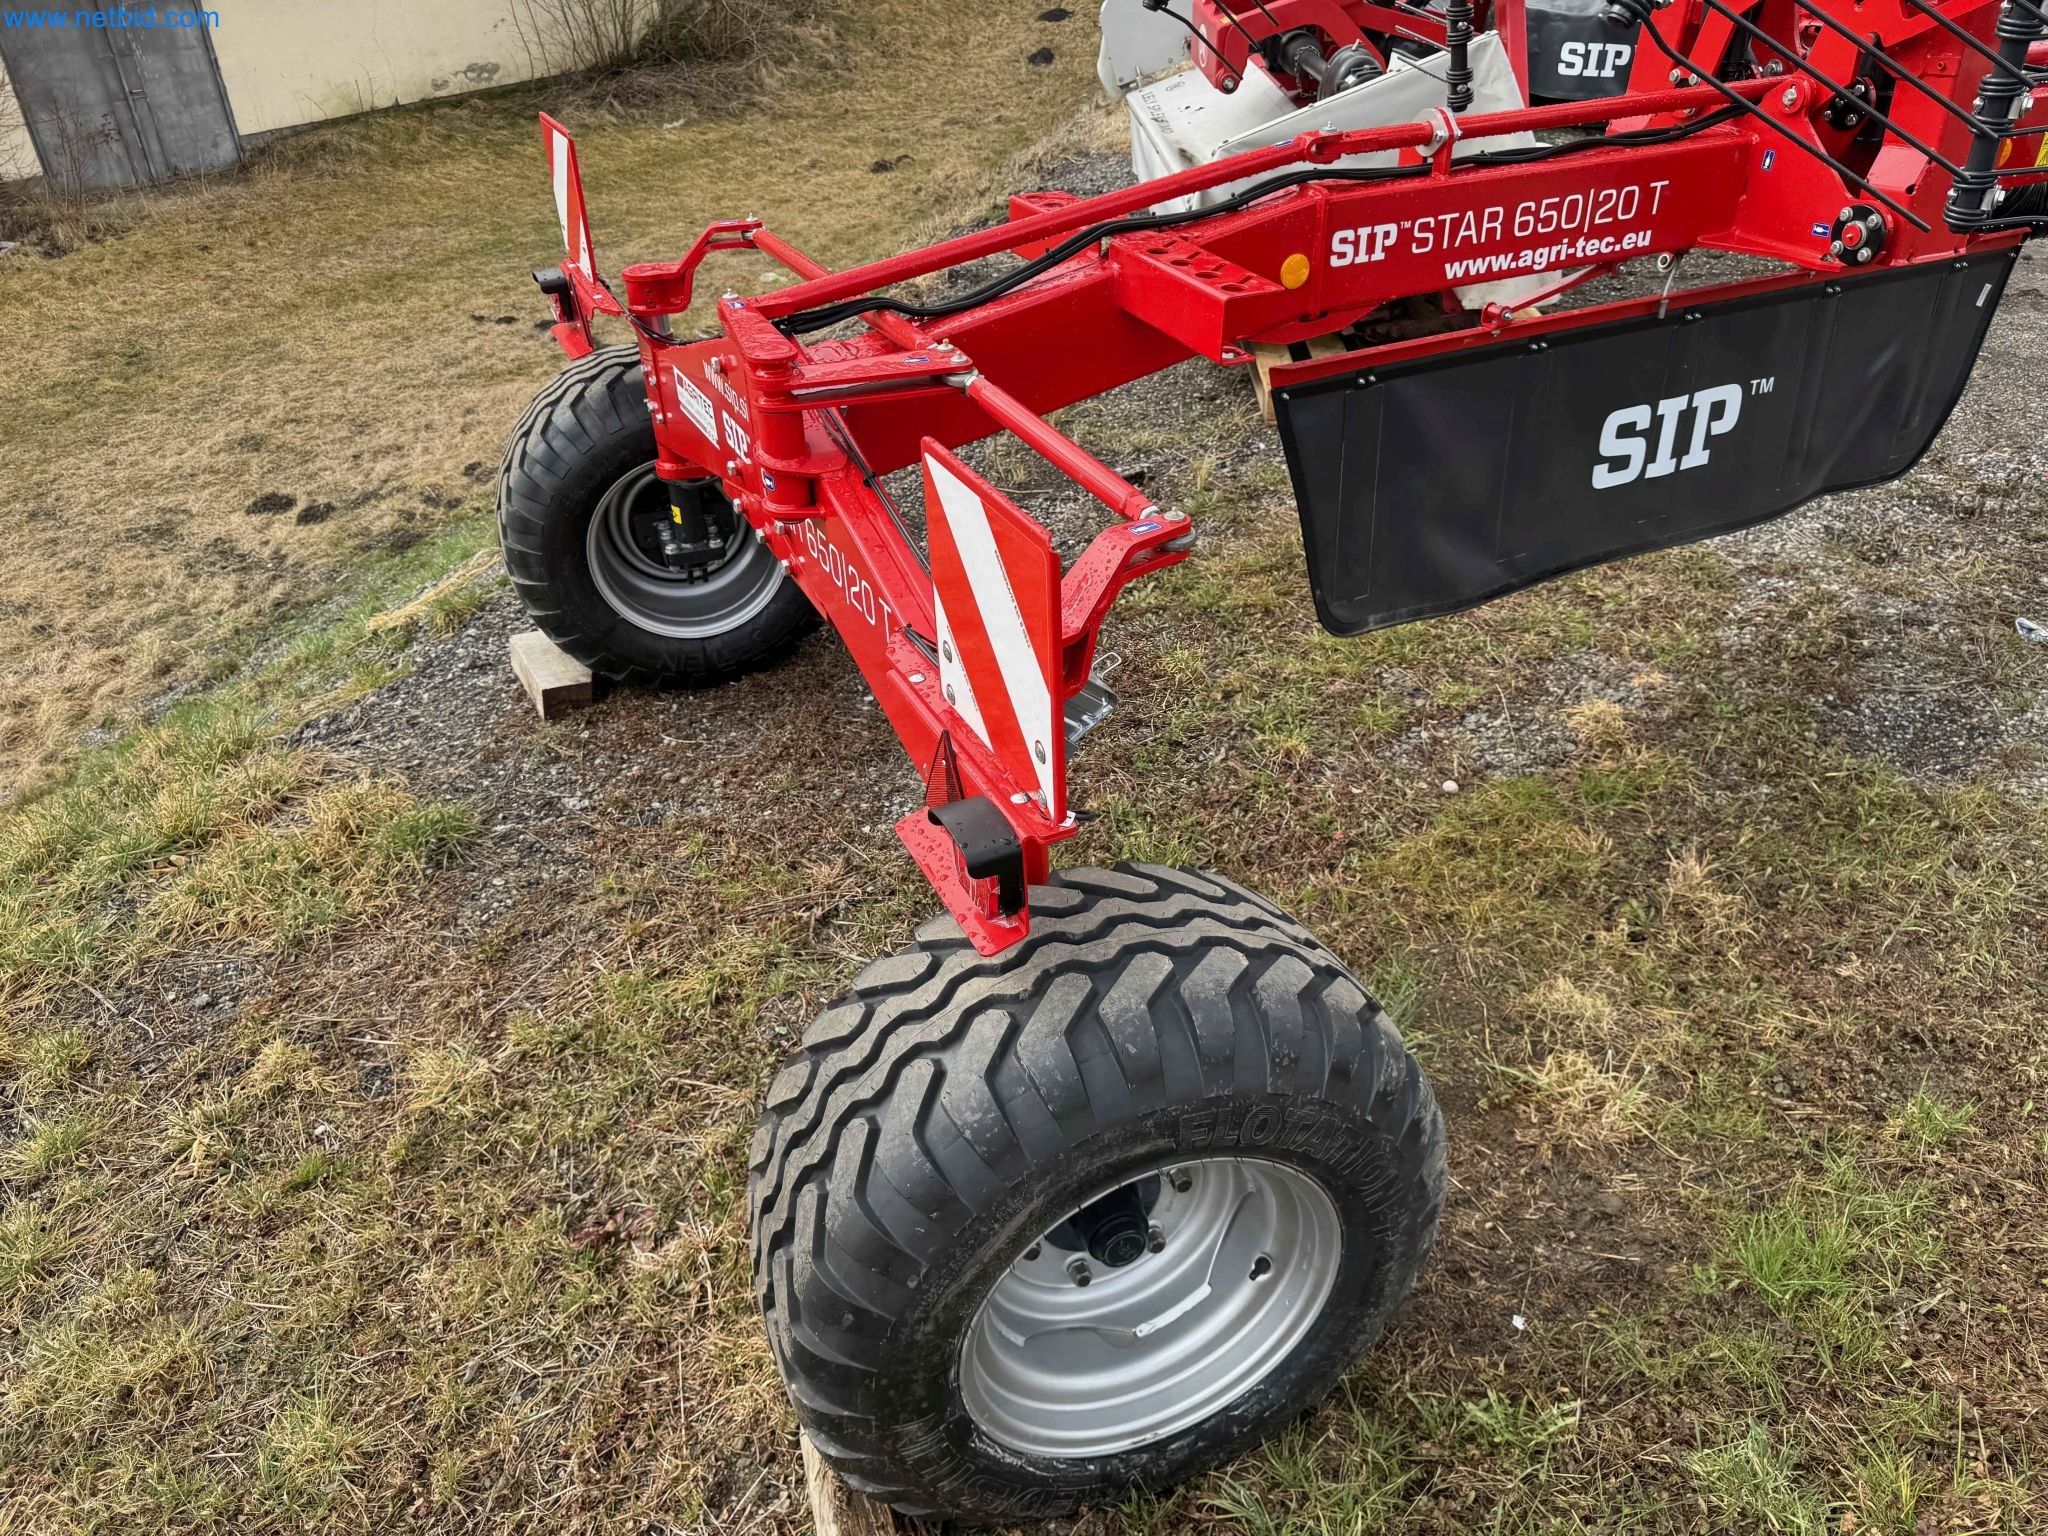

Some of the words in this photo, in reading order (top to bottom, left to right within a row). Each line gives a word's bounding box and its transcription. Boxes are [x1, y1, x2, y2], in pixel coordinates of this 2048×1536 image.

[1557, 41, 1632, 77] SIP
[1330, 223, 1398, 267] SIP
[1412, 206, 1504, 253] STAR
[1650, 180, 1669, 215] T
[1444, 229, 1652, 280] www.agri-tec.eu
[722, 409, 752, 465] SIP
[1592, 383, 1743, 490] SIP
[878, 596, 892, 644] T
